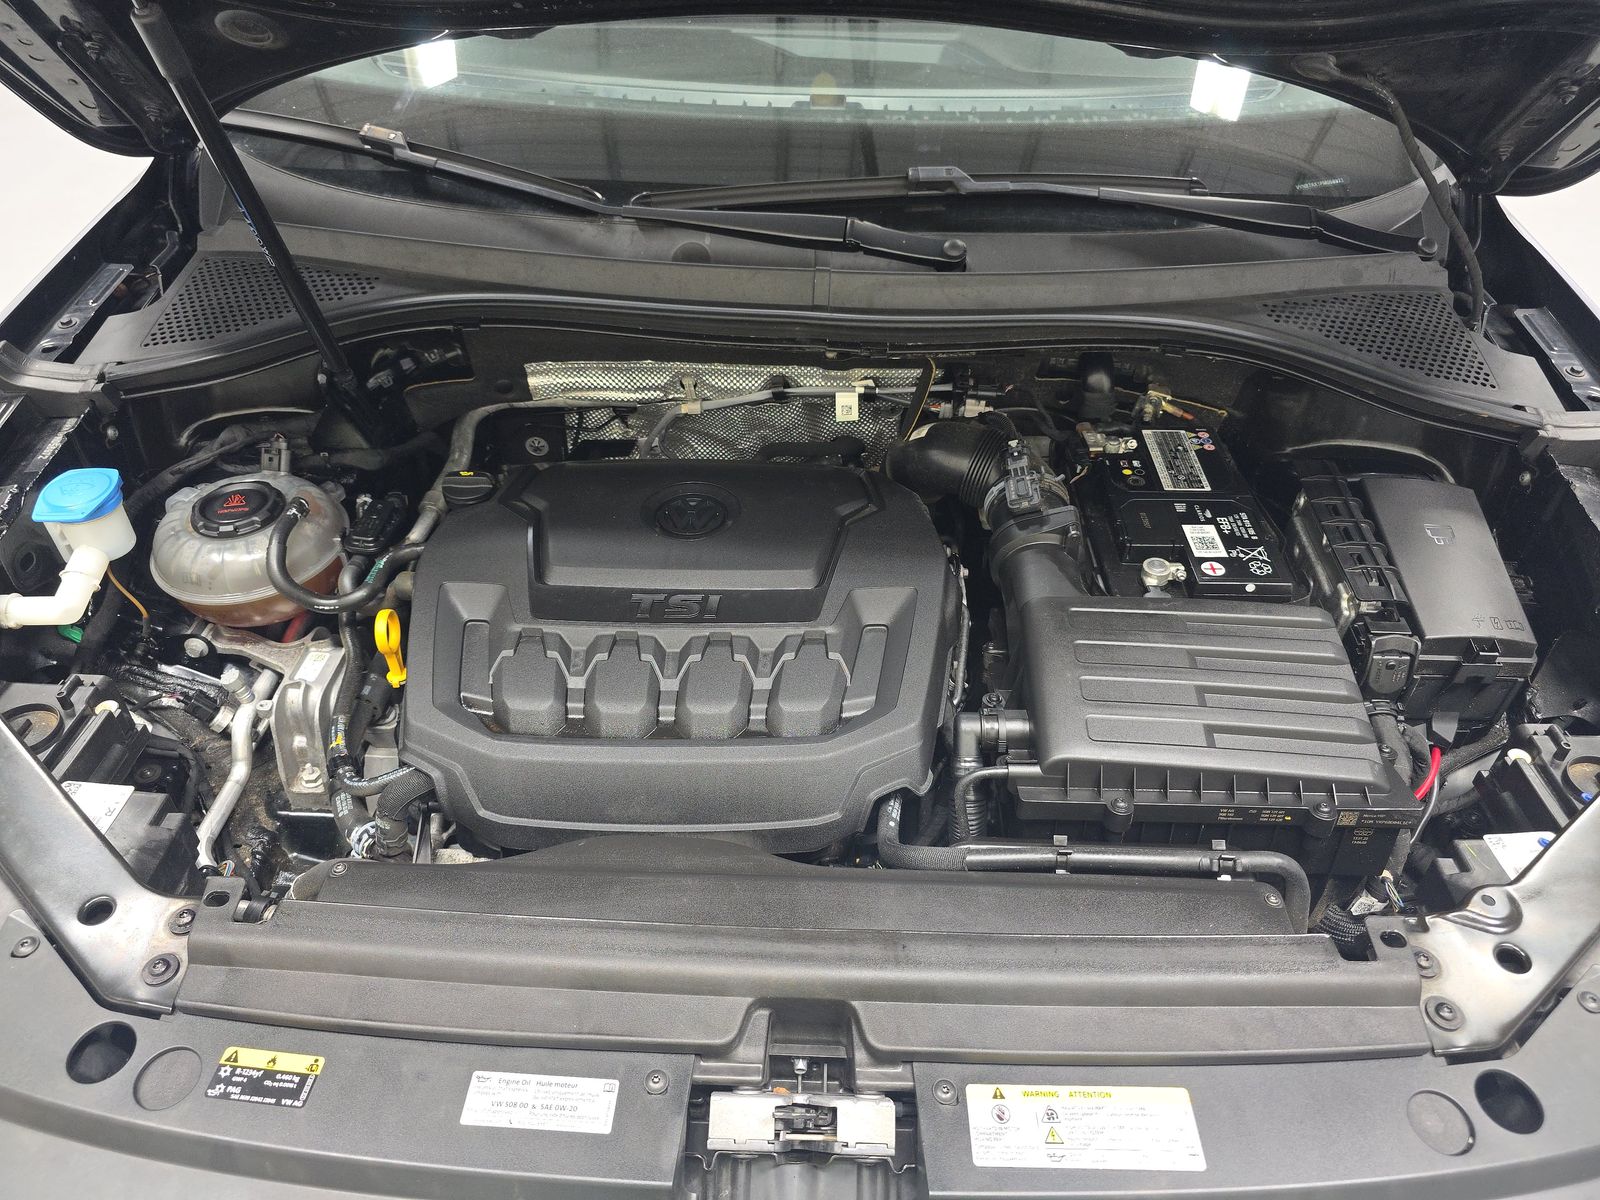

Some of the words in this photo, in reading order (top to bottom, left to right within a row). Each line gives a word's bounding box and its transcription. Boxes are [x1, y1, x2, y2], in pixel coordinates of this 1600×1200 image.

[1216, 517, 1231, 534] EFB+
[631, 593, 722, 618] TSI
[498, 1078, 520, 1087] Engine
[226, 1085, 242, 1094] PAG
[1022, 1090, 1060, 1098] WARNING
[1068, 1090, 1112, 1099] ATTENTION
